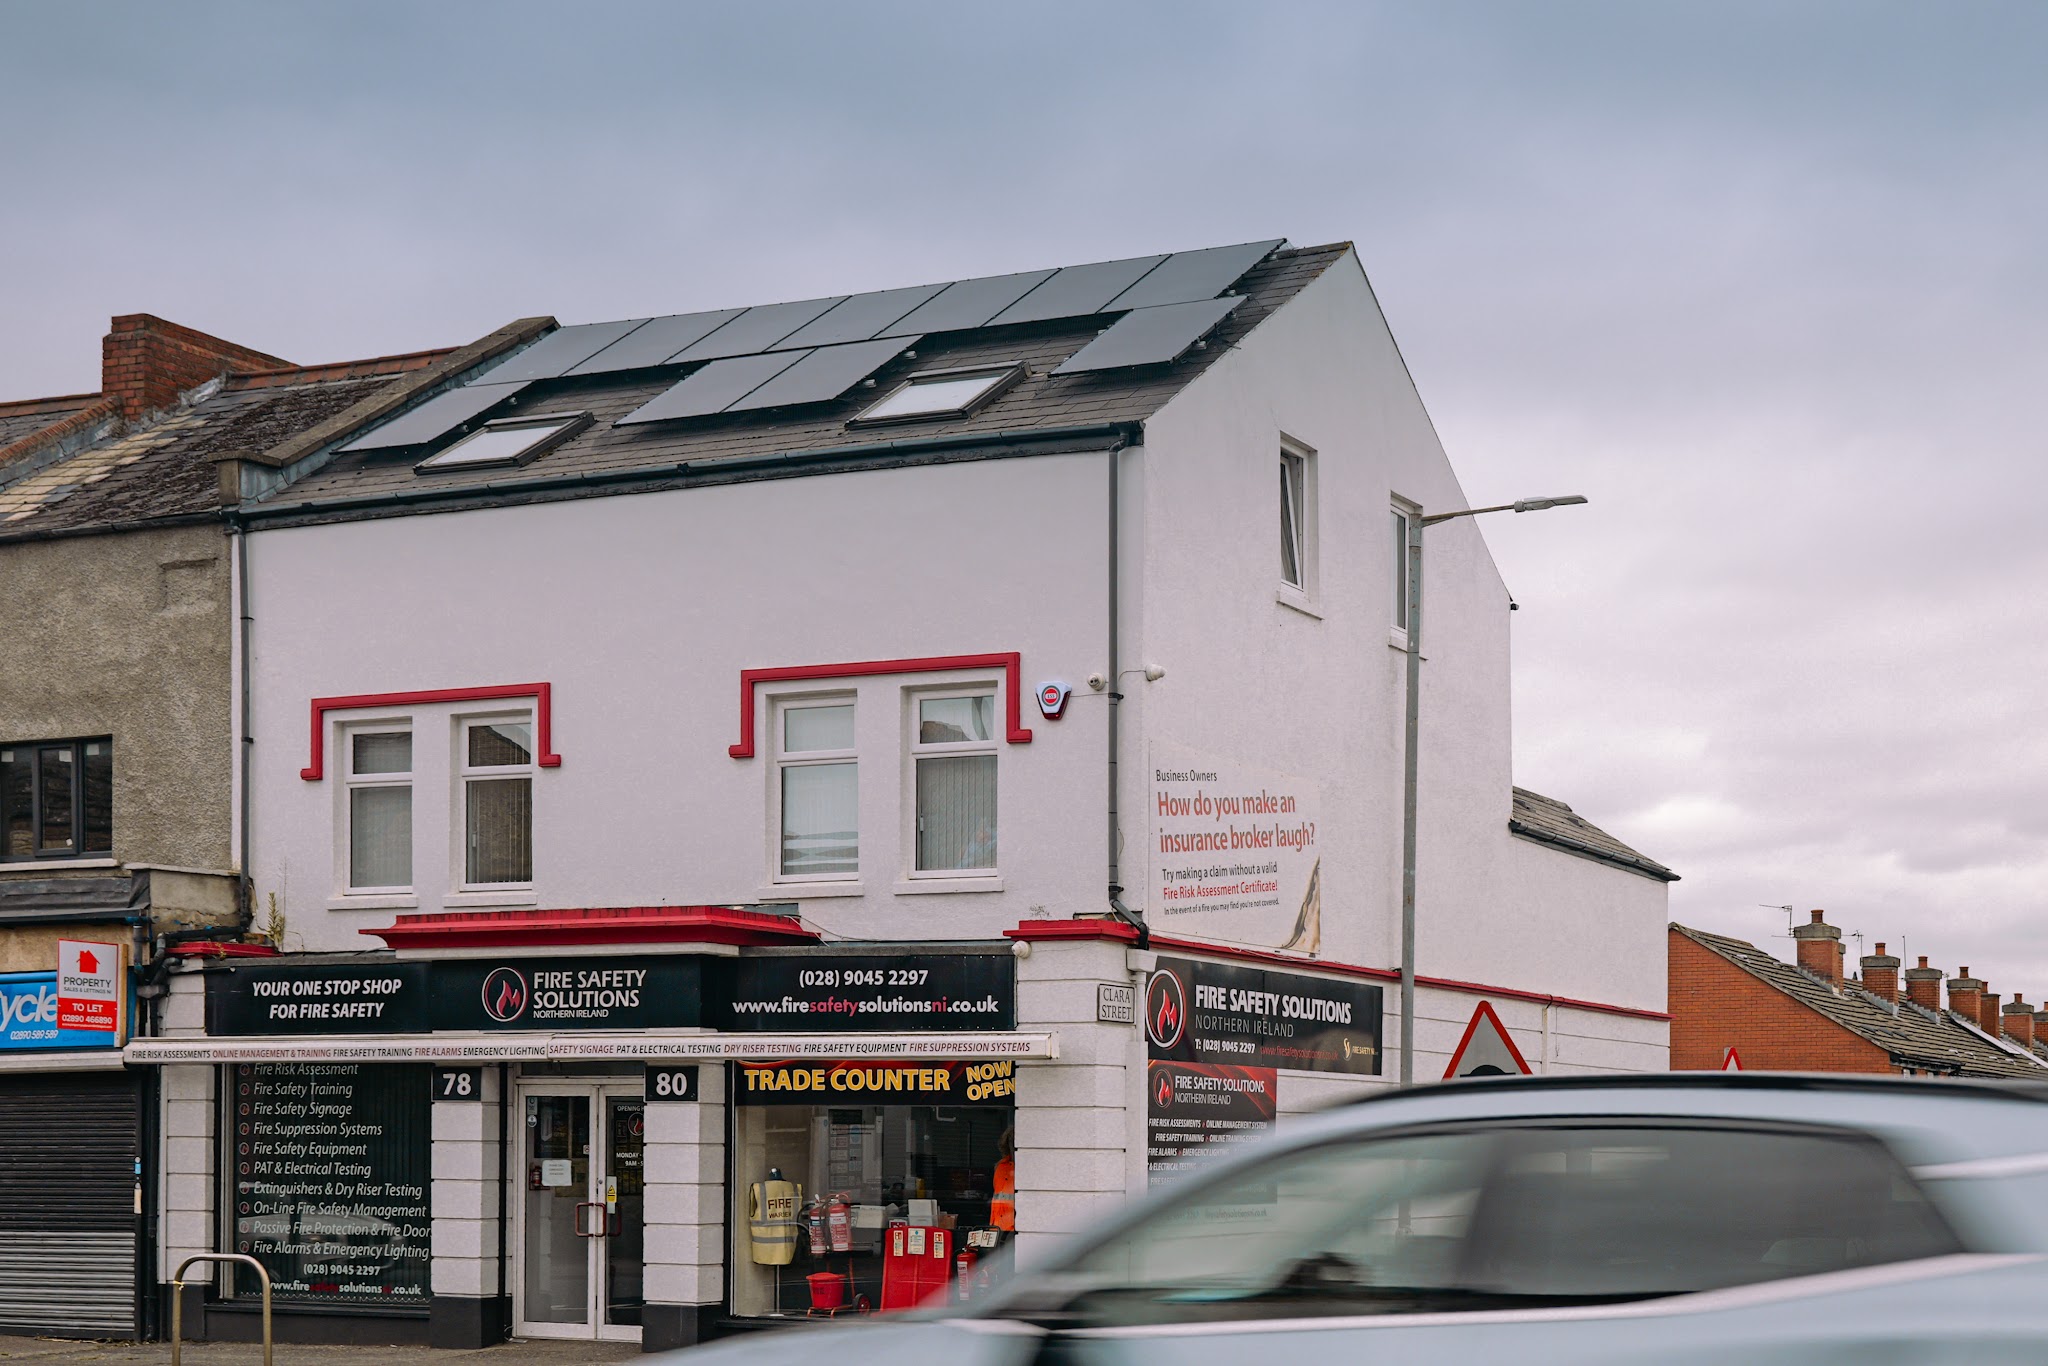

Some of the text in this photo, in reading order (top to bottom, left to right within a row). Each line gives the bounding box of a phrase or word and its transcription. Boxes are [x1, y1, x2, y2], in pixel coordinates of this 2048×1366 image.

[1156, 769, 1217, 782] Business Owners
[1158, 789, 1295, 822] How do you make an
[1160, 822, 1314, 852] insurance broker laugh?
[1162, 861, 1277, 883] Try making claim without valid
[1163, 880, 1278, 900] Fire Risk Assessment Certificate!
[1179, 906, 1192, 914] event
[1202, 904, 1210, 912] fire
[1210, 905, 1219, 914] you
[1220, 904, 1229, 914] may
[63, 976, 111, 988] PROPERTY
[534, 970, 647, 989] FIRE SAFETY
[799, 969, 928, 988] (028) 9045 2297
[252, 979, 402, 996] YOUR ONE STOP SHOP
[1103, 988, 1130, 1003] CLARA
[72, 1003, 103, 1012] TO LET
[533, 990, 639, 1009] SOLUTIONS
[732, 995, 999, 1017] www.firesafetysolutionsni.co.uk
[1195, 984, 1352, 1024] FIRE SAFETY SOLUTIONS
[0, 986, 57, 1032] ycle
[269, 1002, 384, 1019] FOR FIRE SAFETY
[533, 1009, 609, 1018] NORTHERN IRELAND
[1102, 1005, 1131, 1020] STREET
[62, 1014, 84, 1022] 02890
[1195, 1015, 1294, 1037] NORTHERN IRELAND
[148, 1050, 162, 1058] RISK
[163, 1050, 210, 1058] ASSESSMENTS
[212, 1050, 238, 1058] ONLINE
[240, 1049, 289, 1058] MANAGEMENT
[297, 1049, 331, 1057] TRAINING
[333, 1049, 348, 1057] FIRE
[350, 1048, 376, 1057] SAFETY
[378, 1048, 412, 1056] TRAINING
[414, 1048, 430, 1056] FIRE
[432, 1047, 462, 1056] ALARMS
[463, 1047, 508, 1056] EMERGENCY
[510, 1047, 545, 1055] LIGHTING
[549, 1042, 1030, 1054] SAFETY SIGNAGE PAT ELECTRICAL TESTING DRY RISER TESTING FIRE SAFETY EQUIPMENT FIRE SUPPRESSION SYSTEMS
[1194, 1039, 1256, 1054] T: (028) 9045 2297
[254, 1063, 359, 1075] Fire Risk Assessment
[966, 1060, 1012, 1084] NOW
[442, 1073, 471, 1096] 78
[656, 1072, 687, 1096] 80
[744, 1068, 950, 1091] TRADE COUNTER
[1175, 1075, 1265, 1093] FIRE SAFETY SOLUTIONS
[254, 1083, 352, 1098] Fire Safety Training
[966, 1077, 1015, 1101] OPEN
[1175, 1093, 1231, 1105] NORTHERN IRELAND
[254, 1102, 352, 1118] Fire Safety Signage
[254, 1122, 382, 1138] Fire Suppression Systems
[1148, 1118, 1201, 1128] FIRE RISK ASSESSMENTS
[1155, 1133, 1183, 1142] FIRE SAFETY
[254, 1142, 367, 1158] Fire Safety Equipment
[1148, 1148, 1178, 1156] FIRE ALARMS
[254, 1162, 372, 1178] PAT Electrical Testing
[254, 1181, 422, 1199] Extinguishers Dry Riser Testing
[254, 1201, 426, 1219] On-Line Fire Safety Management
[768, 1198, 792, 1210] FIRE
[254, 1221, 431, 1238] Passive Fire Protection Fire Door
[254, 1241, 429, 1260] Fire Alarms Emergency Lighting
[303, 1264, 380, 1276] (028) 9045 2297
